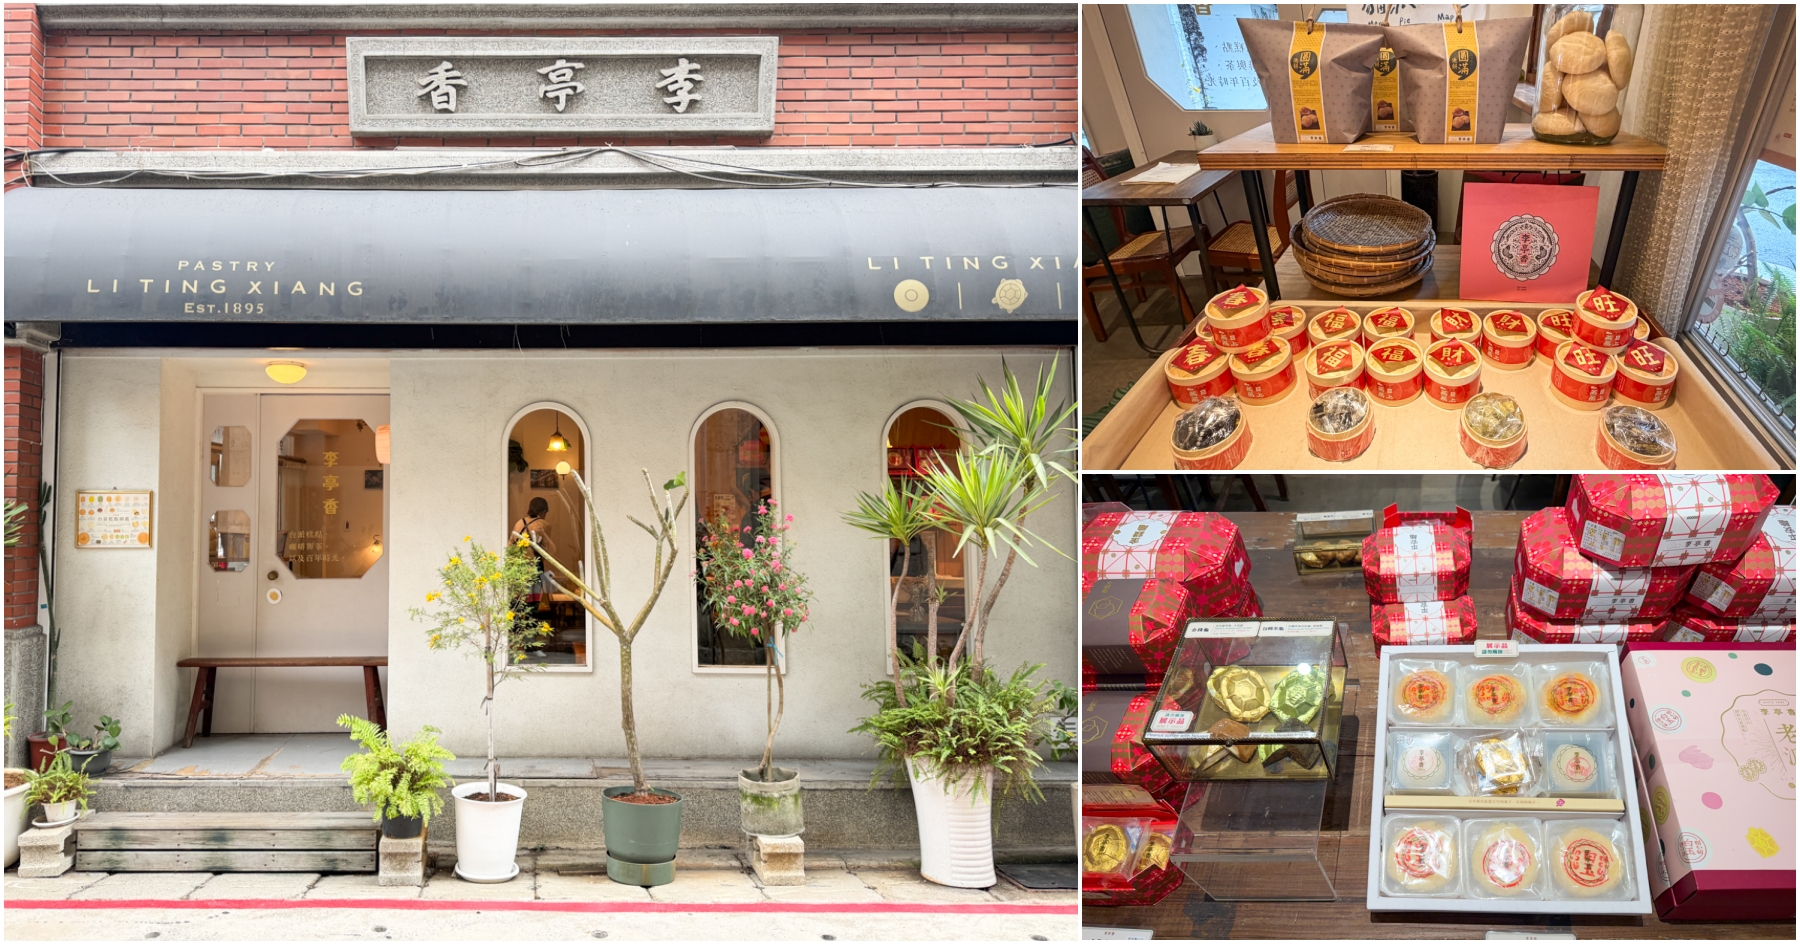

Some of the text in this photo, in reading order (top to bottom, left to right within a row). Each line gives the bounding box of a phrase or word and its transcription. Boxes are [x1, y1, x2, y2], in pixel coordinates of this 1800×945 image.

[1399, 13, 1454, 26] Pie Map
[1520, 232, 1531, 264] 李亭香
[177, 260, 276, 272] PASTRY
[867, 256, 899, 270] LI
[919, 256, 1009, 270] TING
[86, 279, 364, 296] LI TING XIANG
[1222, 291, 1249, 306] 春
[1592, 294, 1621, 313] 旺
[1324, 312, 1348, 329] 福
[1377, 313, 1401, 328] 福
[1444, 311, 1469, 330] 財
[1496, 314, 1521, 330] 財
[1550, 313, 1572, 327] 旺
[1182, 343, 1213, 366] 春
[1320, 345, 1350, 368] 福
[1381, 347, 1406, 361] 福
[1440, 346, 1465, 363] 財
[1572, 346, 1601, 366] 旺
[1630, 345, 1660, 366] 旺
[322, 450, 340, 515] 李亭香
[1158, 717, 1185, 725] 展示品
[1417, 749, 1426, 768] 李亭香
